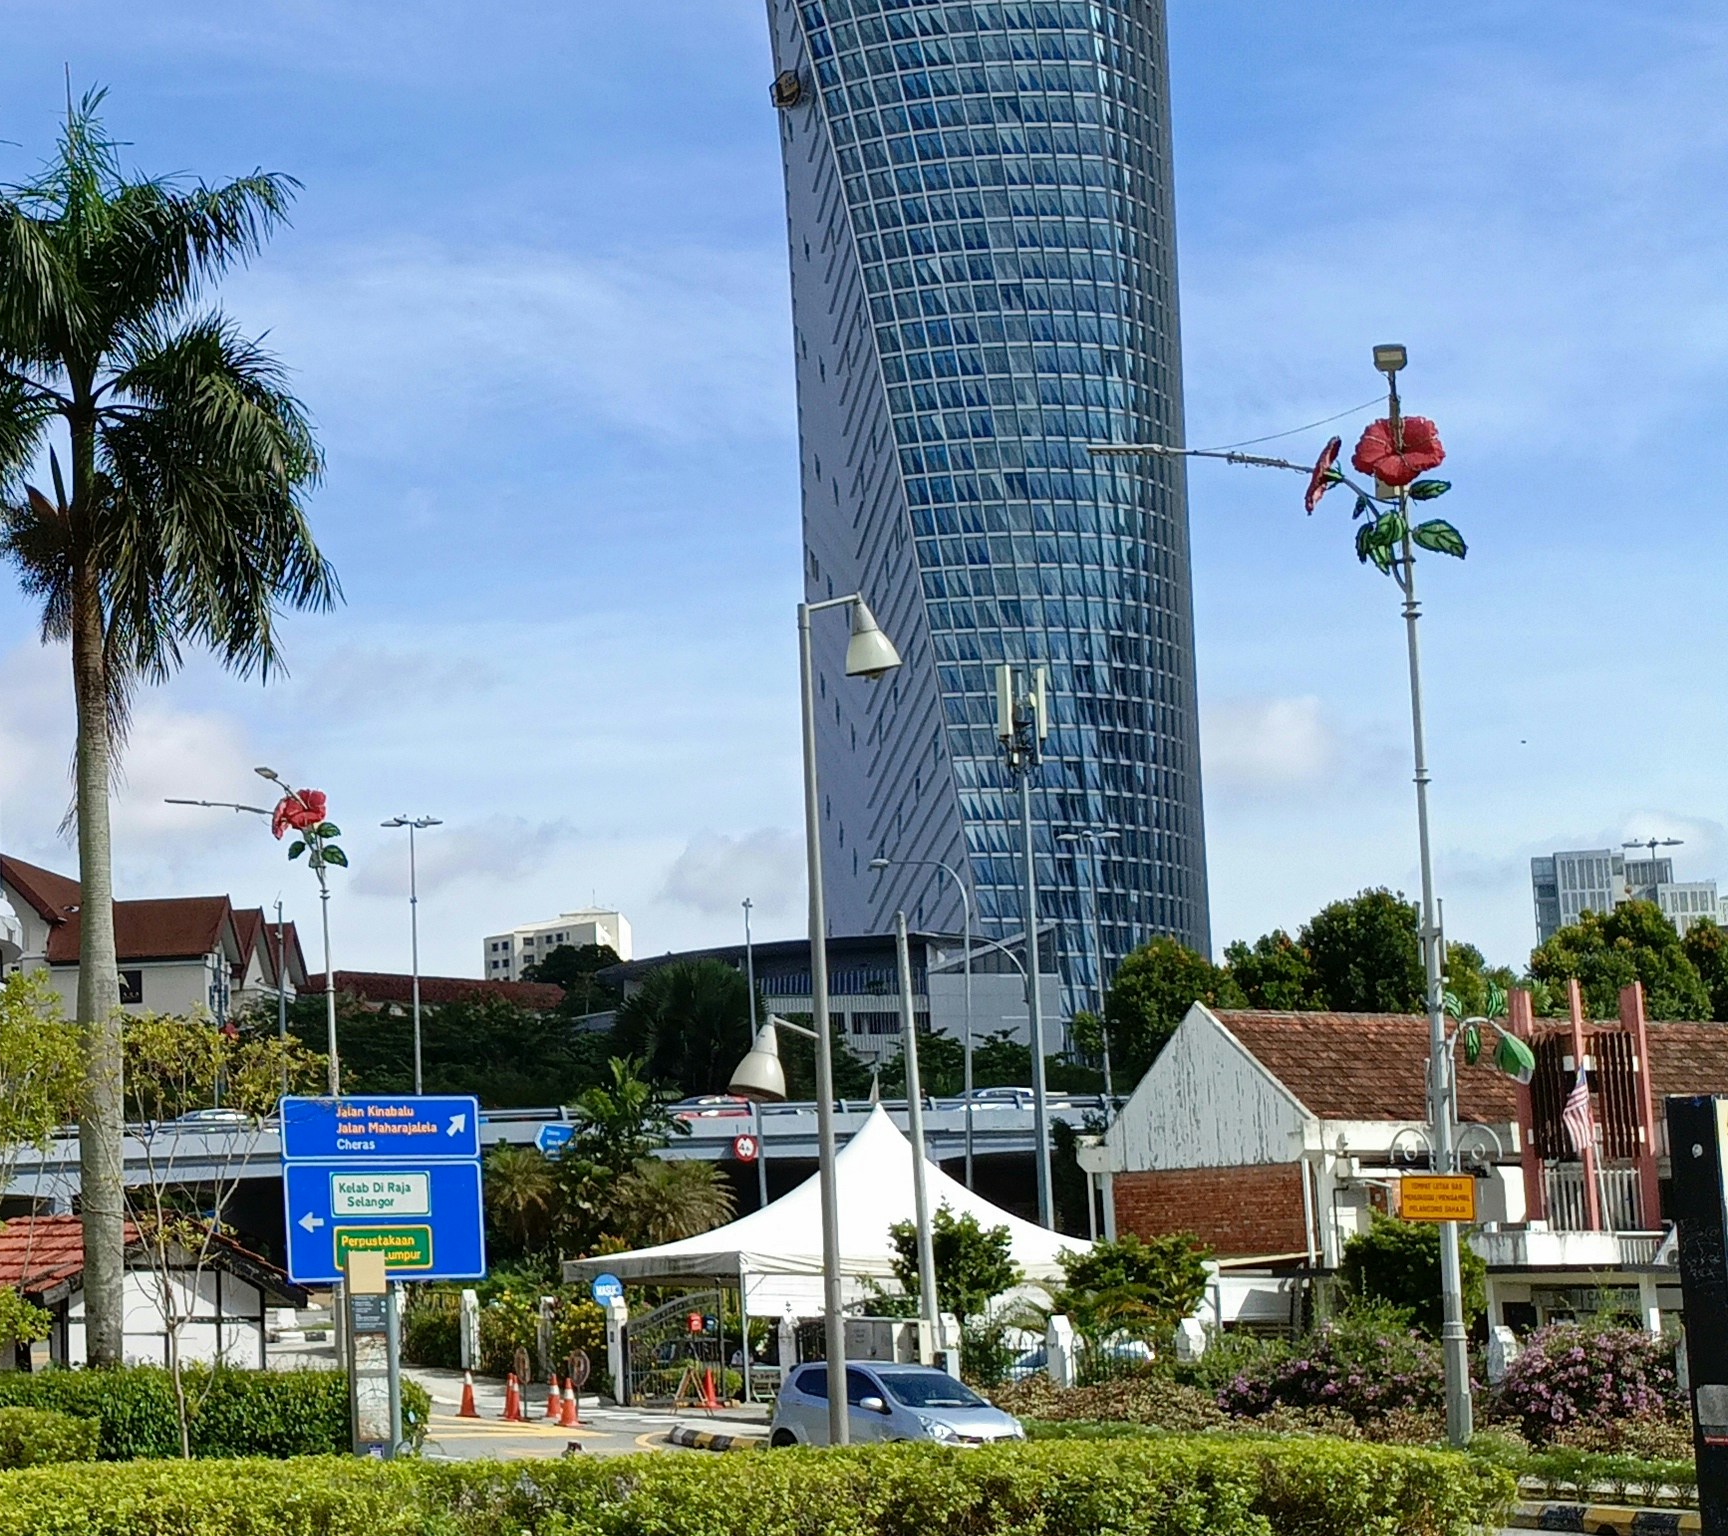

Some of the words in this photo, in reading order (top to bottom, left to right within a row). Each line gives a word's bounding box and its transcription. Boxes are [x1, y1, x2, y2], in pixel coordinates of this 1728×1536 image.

[336, 1106, 364, 1117] Jalan
[367, 1105, 415, 1117] Kinabalu
[336, 1122, 365, 1134] Jalan
[368, 1121, 438, 1135] Maharajalela
[336, 1138, 376, 1150] Cheras
[338, 1183, 369, 1193] Kelab
[373, 1182, 384, 1193] Di
[387, 1182, 412, 1195] Raja
[347, 1196, 395, 1209] Selangor
[341, 1235, 415, 1247] Perpustakaan
